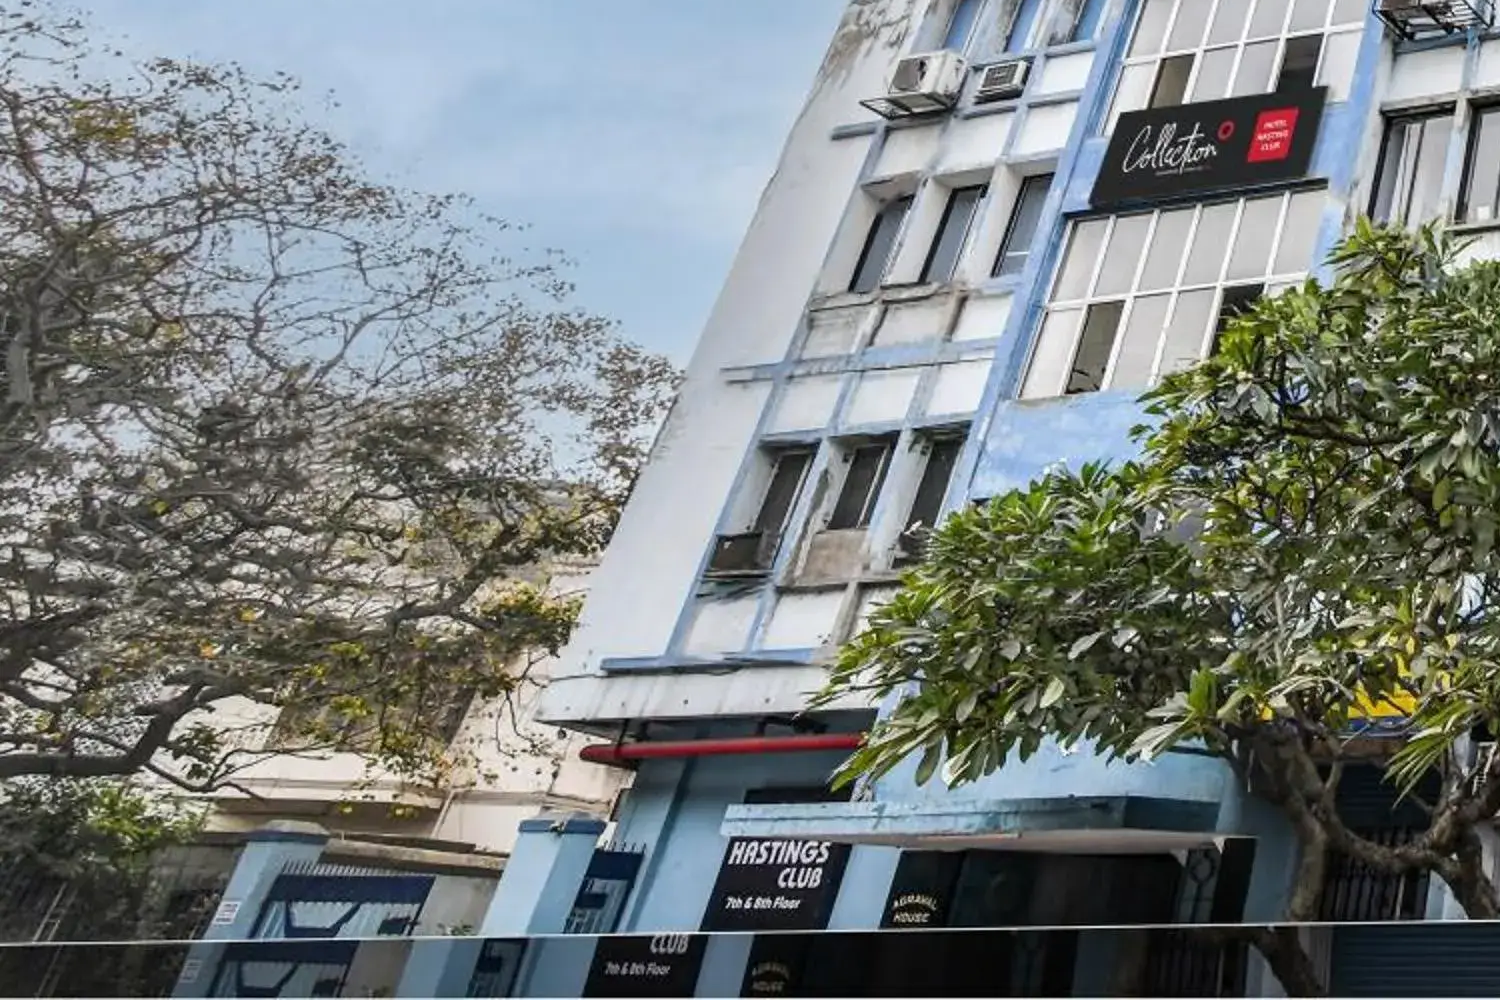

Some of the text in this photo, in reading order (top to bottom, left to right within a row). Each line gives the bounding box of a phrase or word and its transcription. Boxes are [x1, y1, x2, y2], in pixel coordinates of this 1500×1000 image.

[1121, 121, 1217, 175] Collection
[727, 840, 832, 866] HASTINGS
[777, 867, 824, 889] CLUB
[724, 894, 801, 910] 7th & 8th Floor
